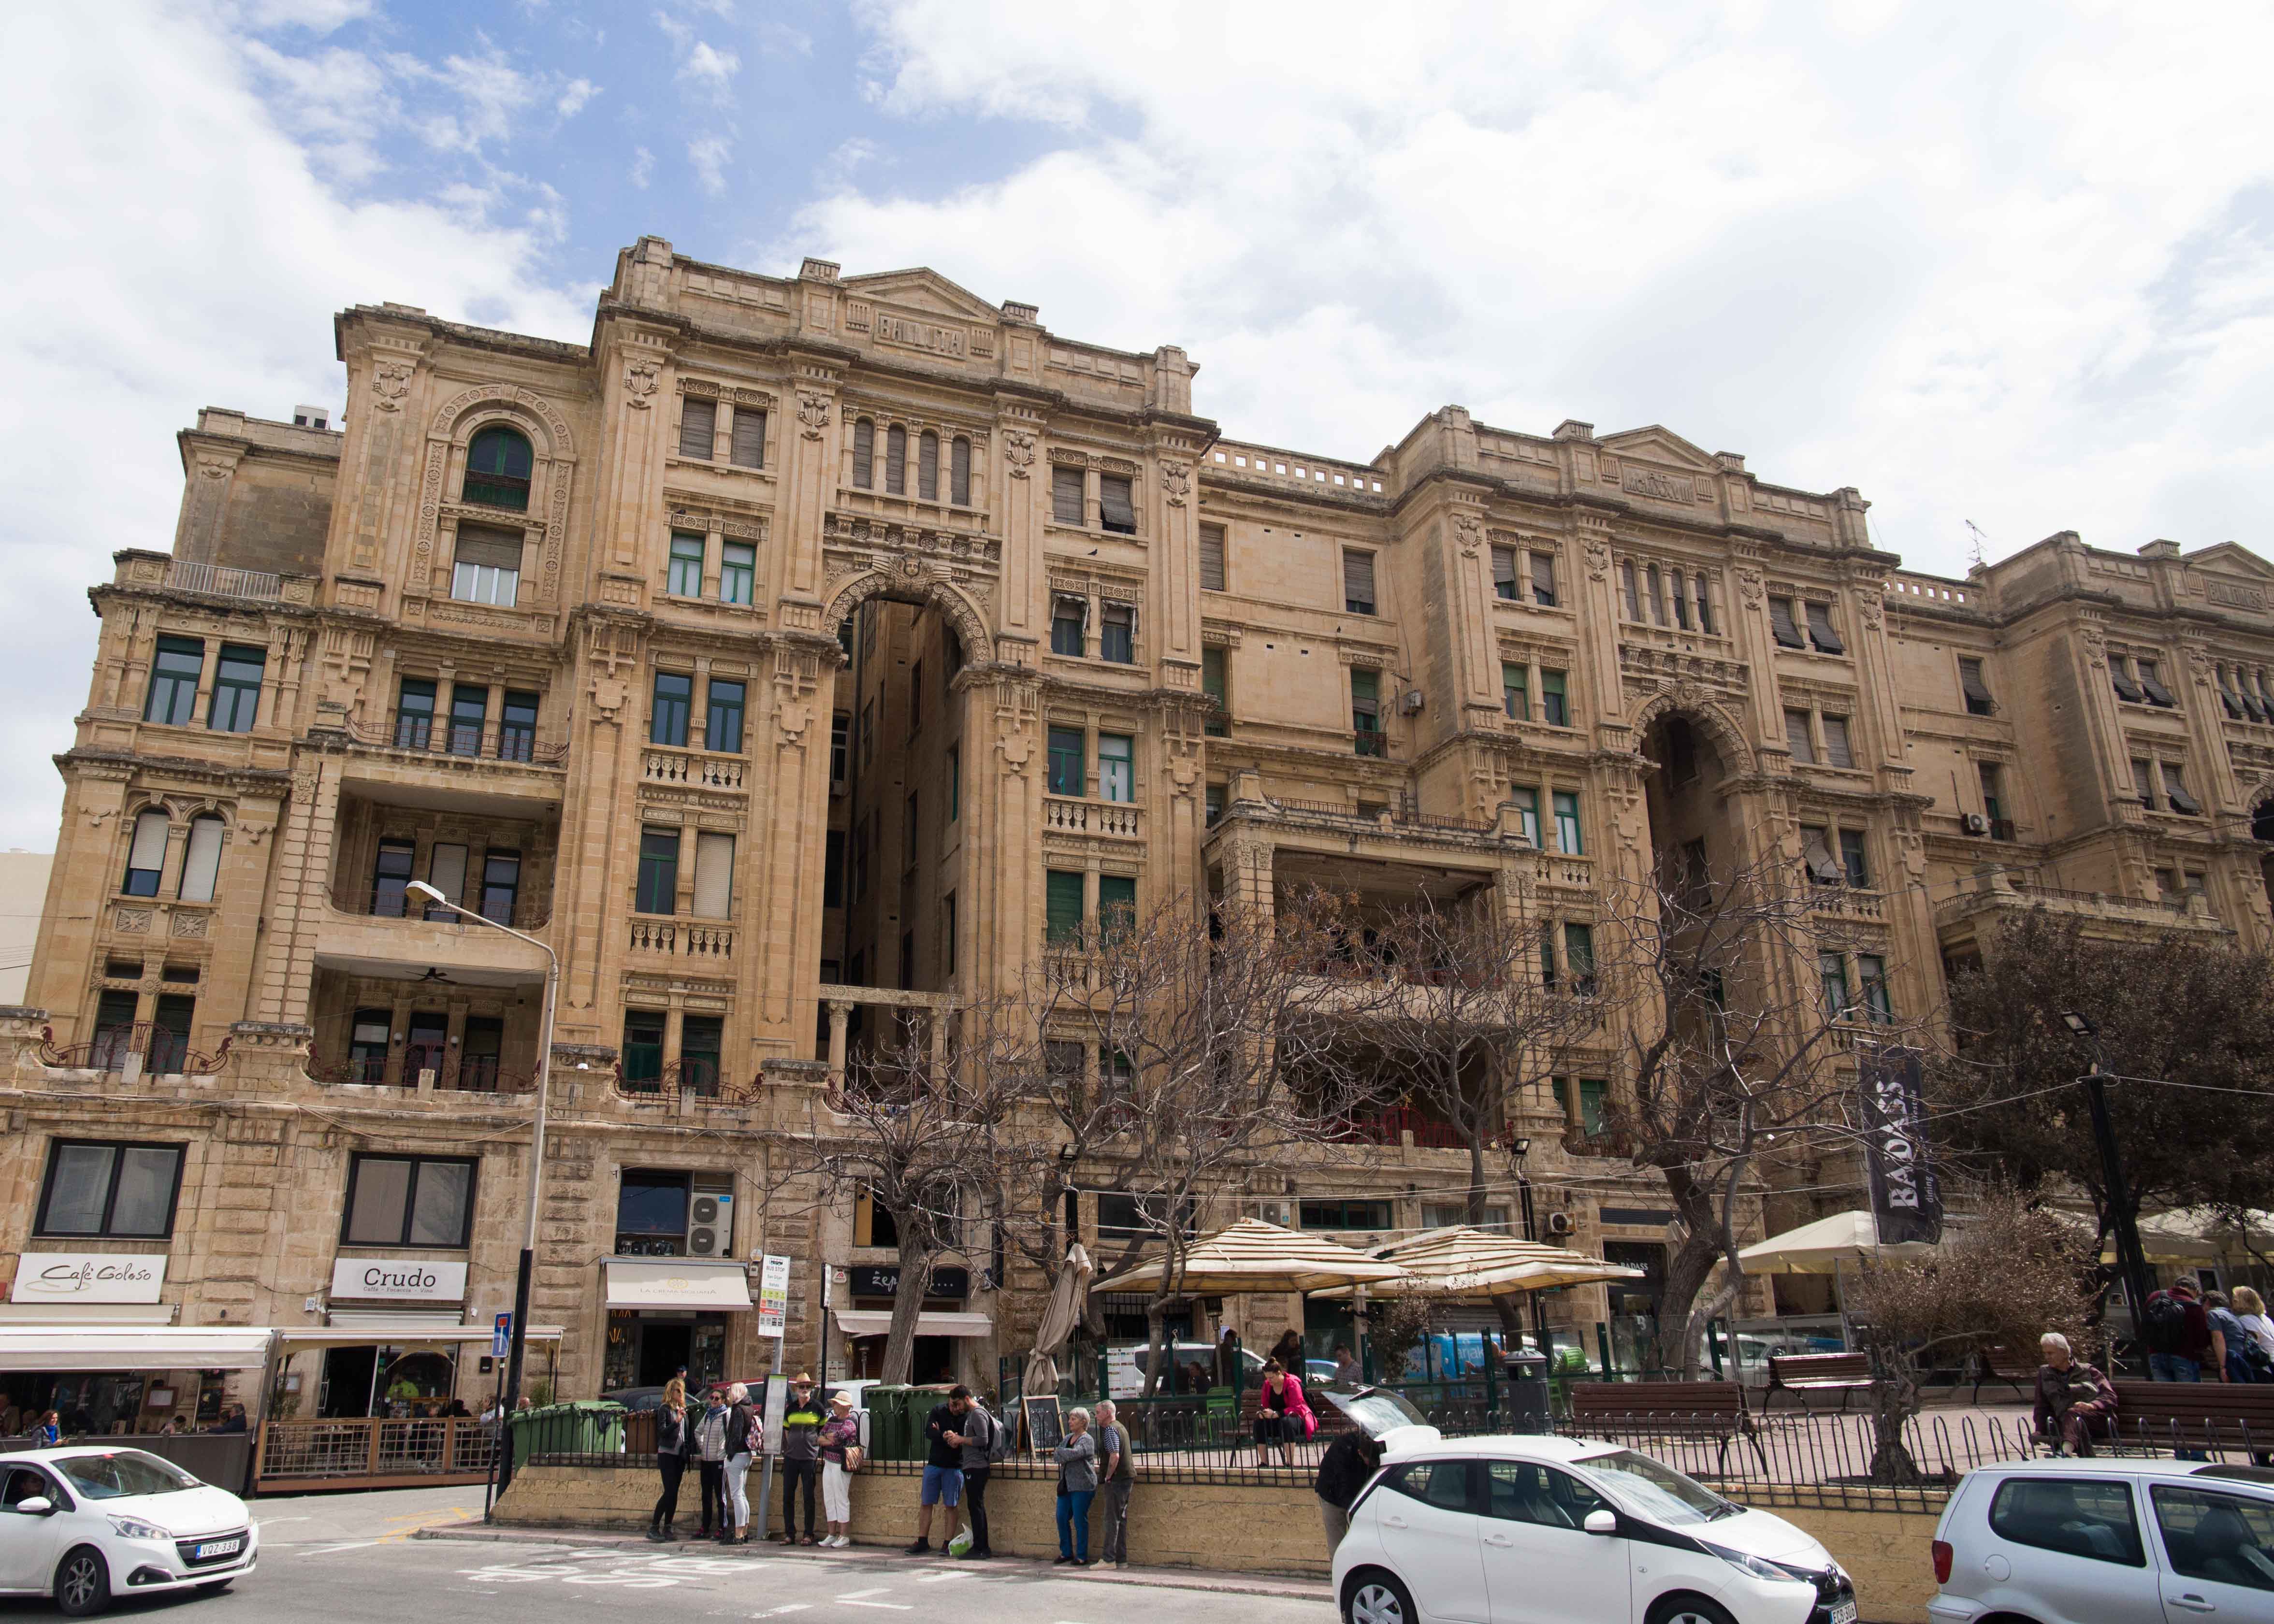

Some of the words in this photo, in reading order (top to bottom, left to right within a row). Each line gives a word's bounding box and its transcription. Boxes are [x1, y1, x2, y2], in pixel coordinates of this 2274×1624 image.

[879, 316, 964, 355] BALLUTA
[2208, 581, 2265, 610] BUILDINGS
[1876, 1081, 1919, 1209] BADASS
[97, 1263, 151, 1280] Goloso
[364, 1268, 436, 1287] Crudo
[222, 1541, 237, 1551] 338
[562, 1558, 770, 1588] BUS
